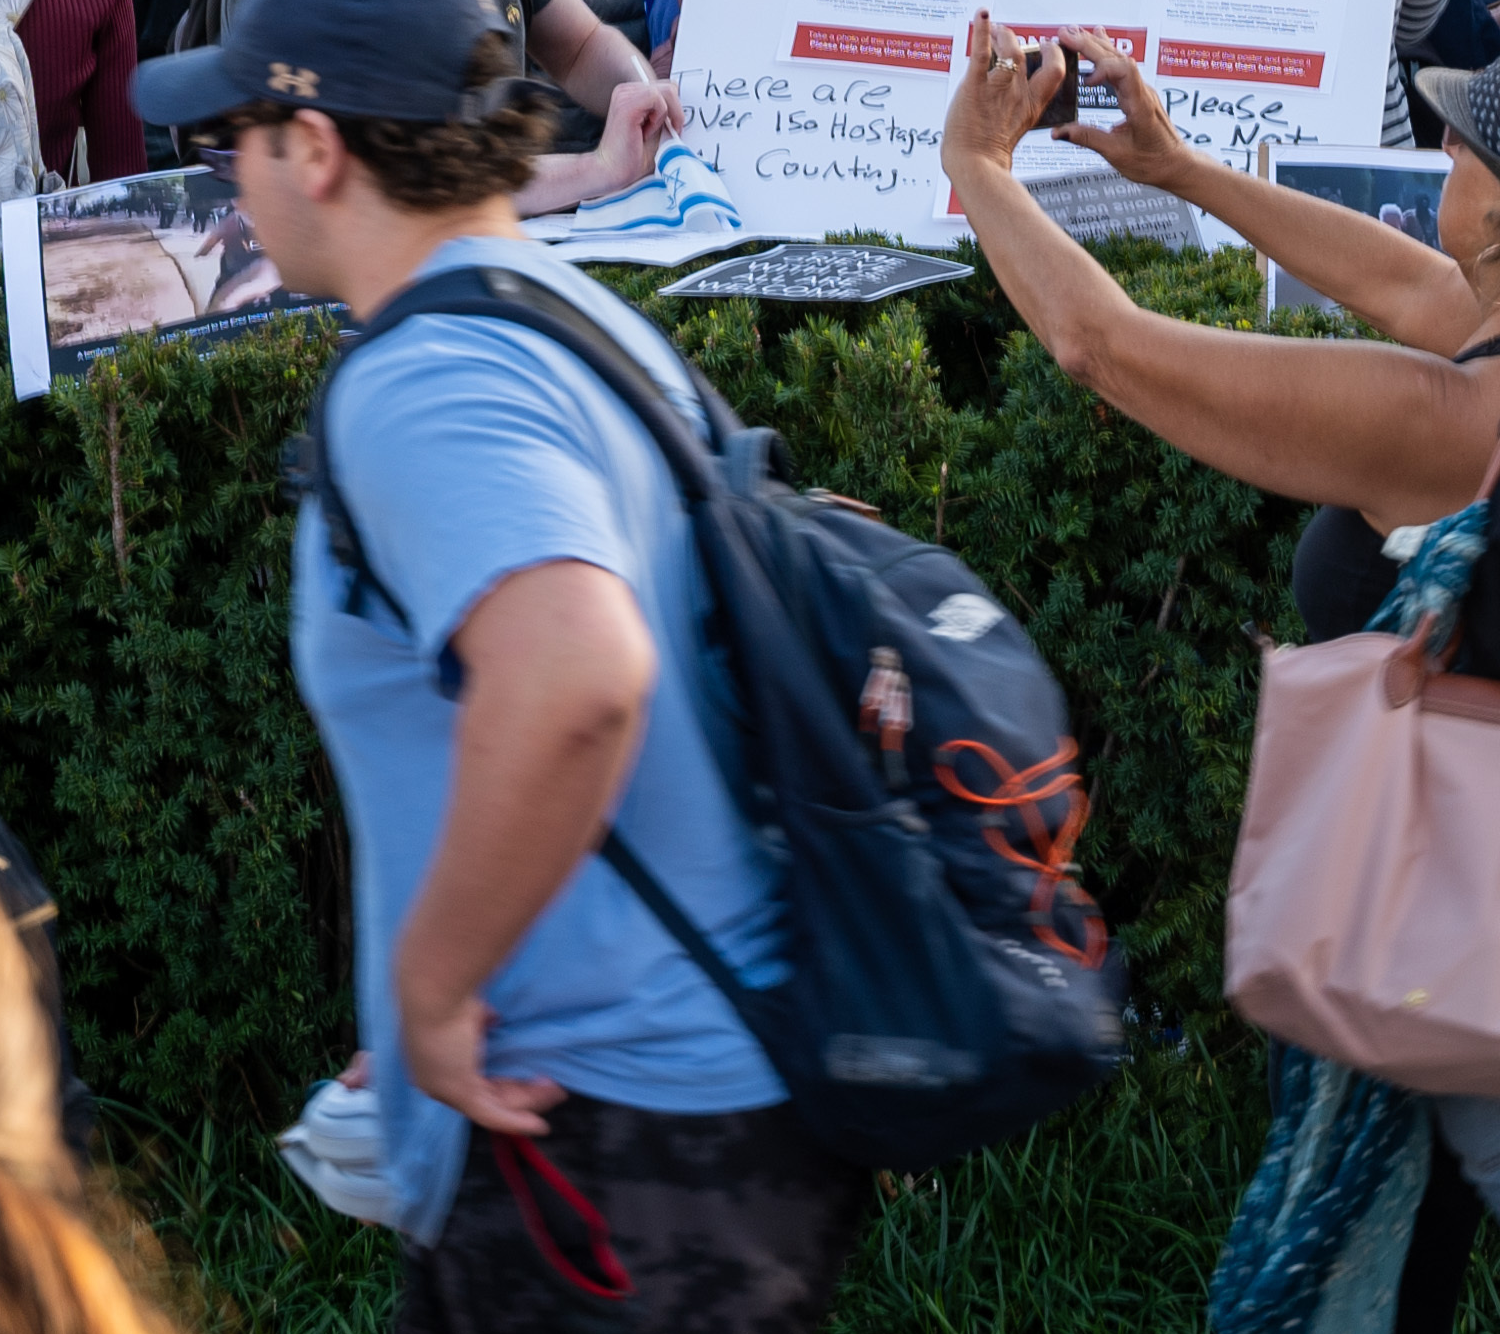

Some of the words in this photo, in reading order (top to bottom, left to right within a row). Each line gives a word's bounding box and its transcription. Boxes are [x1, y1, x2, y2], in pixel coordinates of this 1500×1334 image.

[837, 33, 859, 44] photo
[810, 40, 837, 53] Please
[671, 69, 792, 101] There
[812, 80, 893, 109] are
